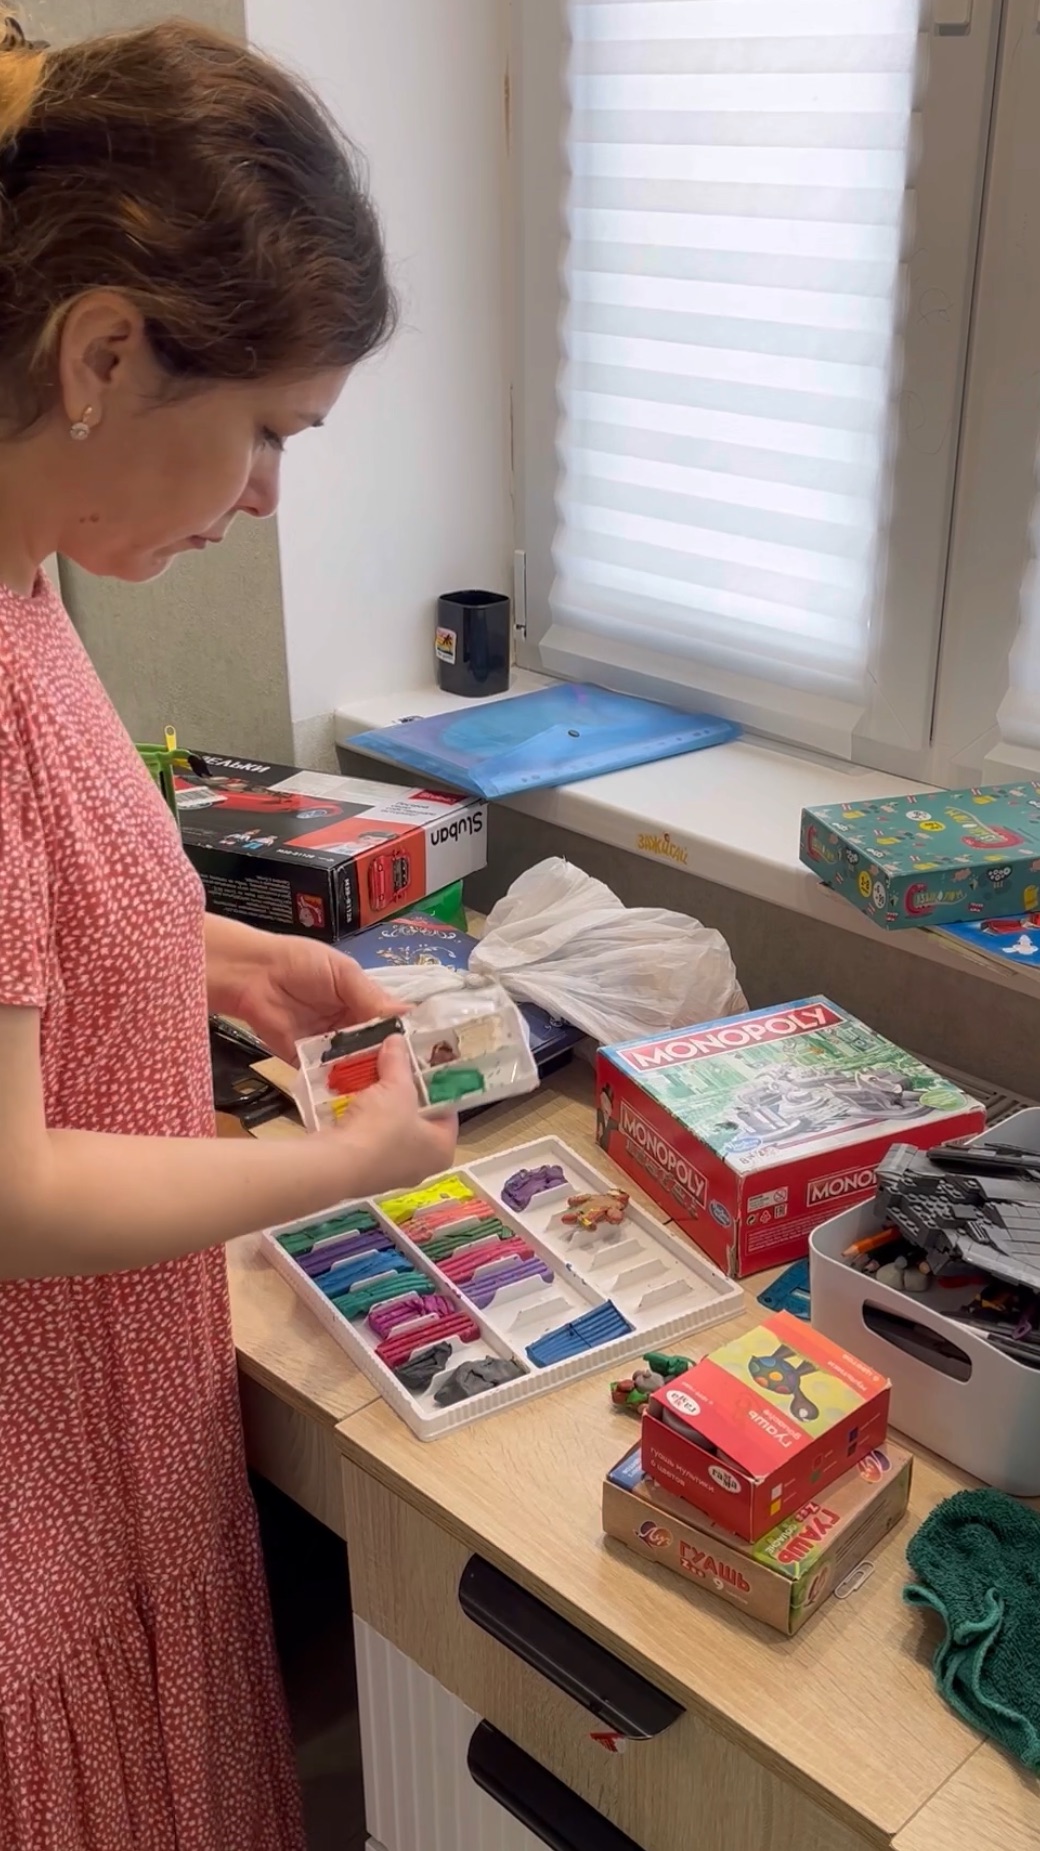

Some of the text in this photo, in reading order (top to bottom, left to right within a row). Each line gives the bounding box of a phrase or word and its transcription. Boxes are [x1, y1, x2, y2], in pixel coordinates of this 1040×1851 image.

[431, 812, 483, 846] Sluban
[631, 1007, 828, 1068] MONOPOLY
[624, 1111, 704, 1197] MONOPOLY
[748, 1410, 793, 1448] гуашь
[777, 1508, 841, 1564] ГУАШЬ
[679, 1540, 751, 1593] ГУАШЬ
